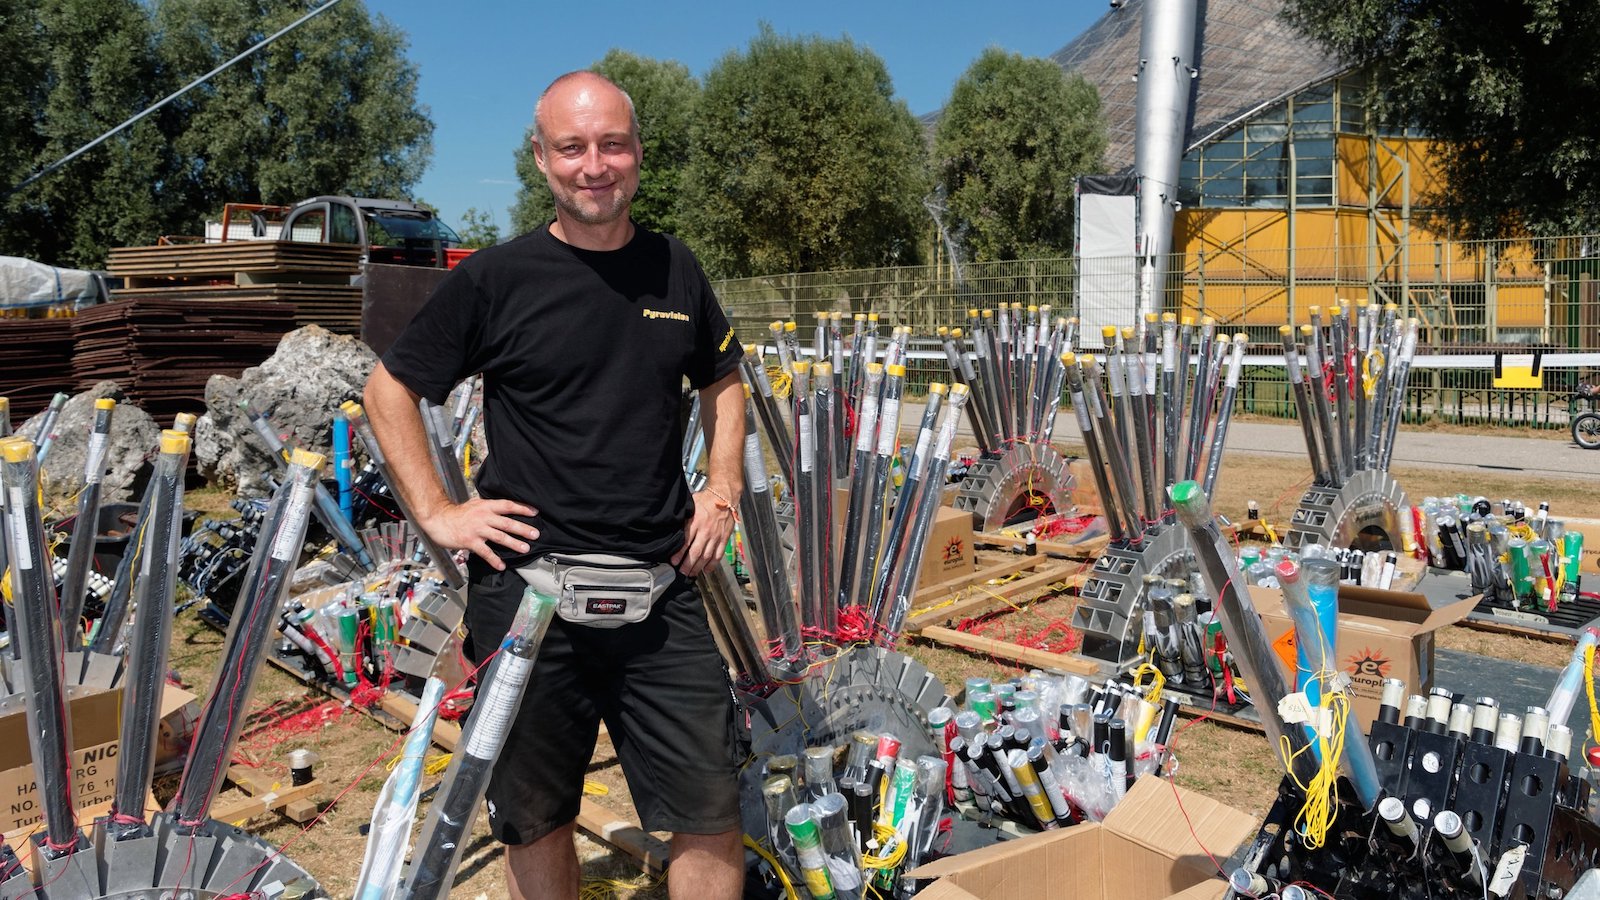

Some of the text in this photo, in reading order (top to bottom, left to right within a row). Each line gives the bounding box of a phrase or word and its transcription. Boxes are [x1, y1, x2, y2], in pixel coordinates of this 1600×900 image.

[643, 309, 690, 322] Pyrovision
[1349, 675, 1385, 688] europl
[17, 765, 97, 796] HA RG
[11, 800, 38, 815] NO.
[12, 794, 112, 829] Tur irbe
